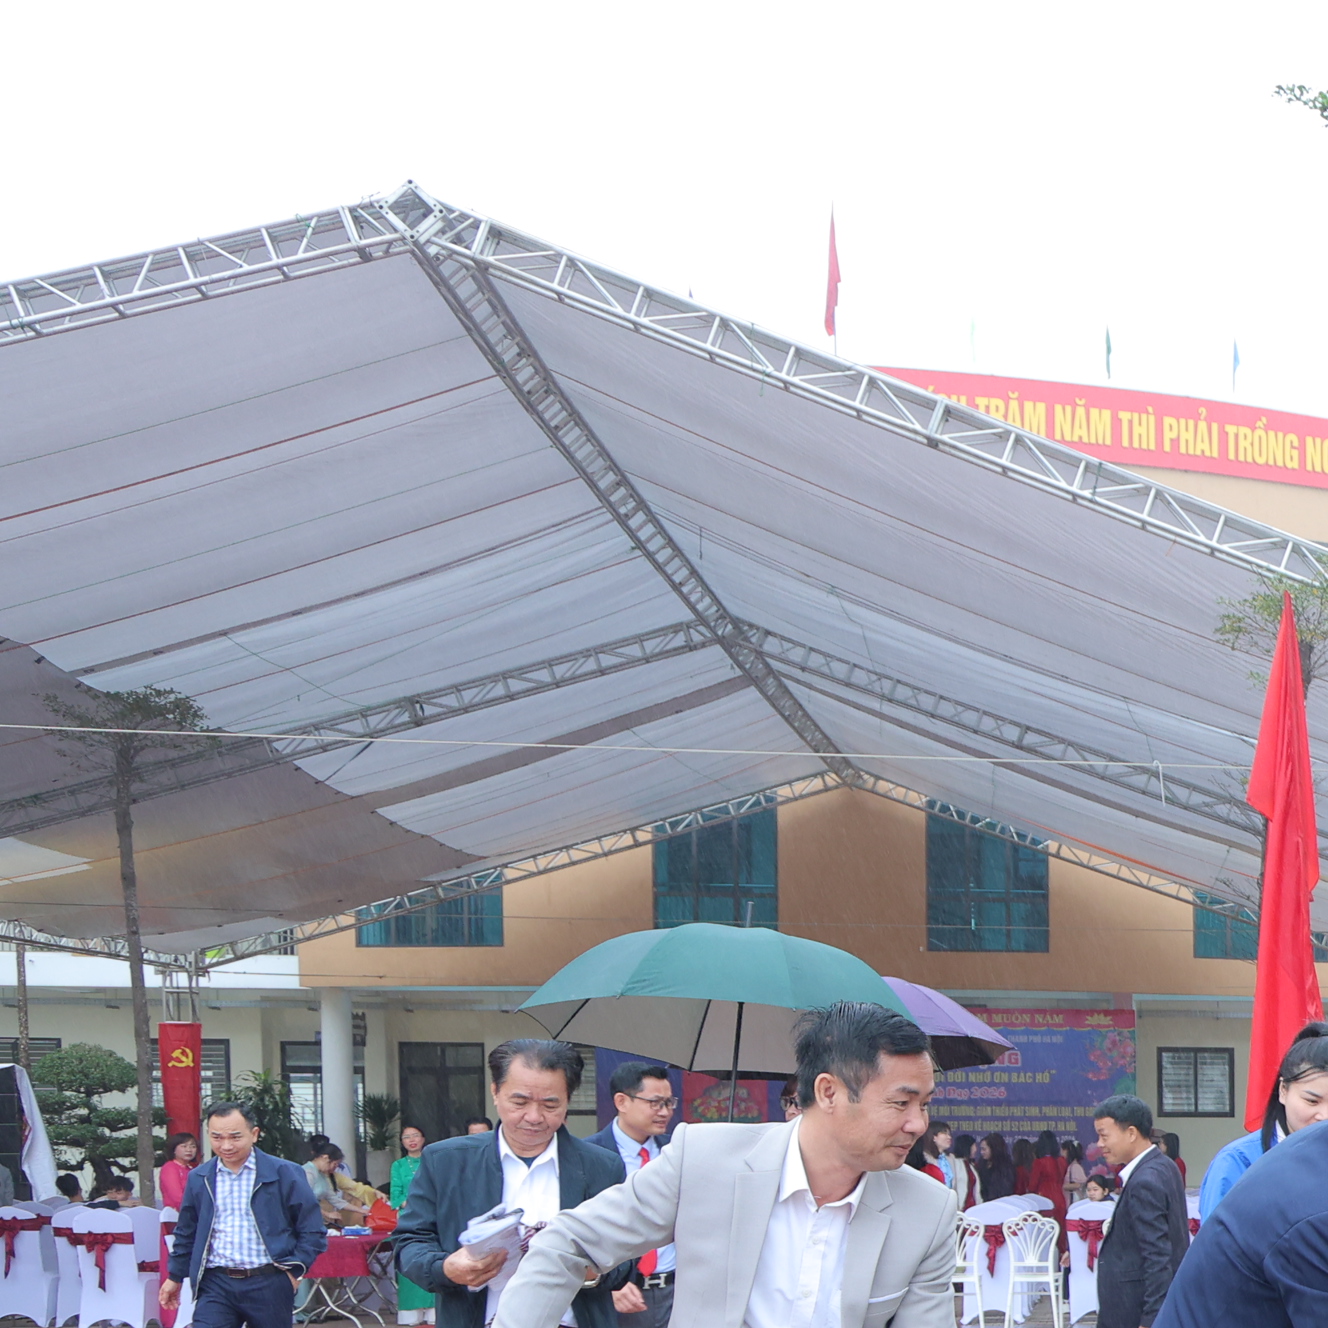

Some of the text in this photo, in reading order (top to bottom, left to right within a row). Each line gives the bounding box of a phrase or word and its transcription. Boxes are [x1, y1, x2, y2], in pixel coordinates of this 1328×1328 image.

[1054, 397, 1112, 446] NĂM
[1118, 406, 1156, 450] THÌ
[1162, 407, 1219, 458] PHẢI
[1224, 416, 1299, 469] TRỒNG
[970, 1086, 1007, 1098] 2026
